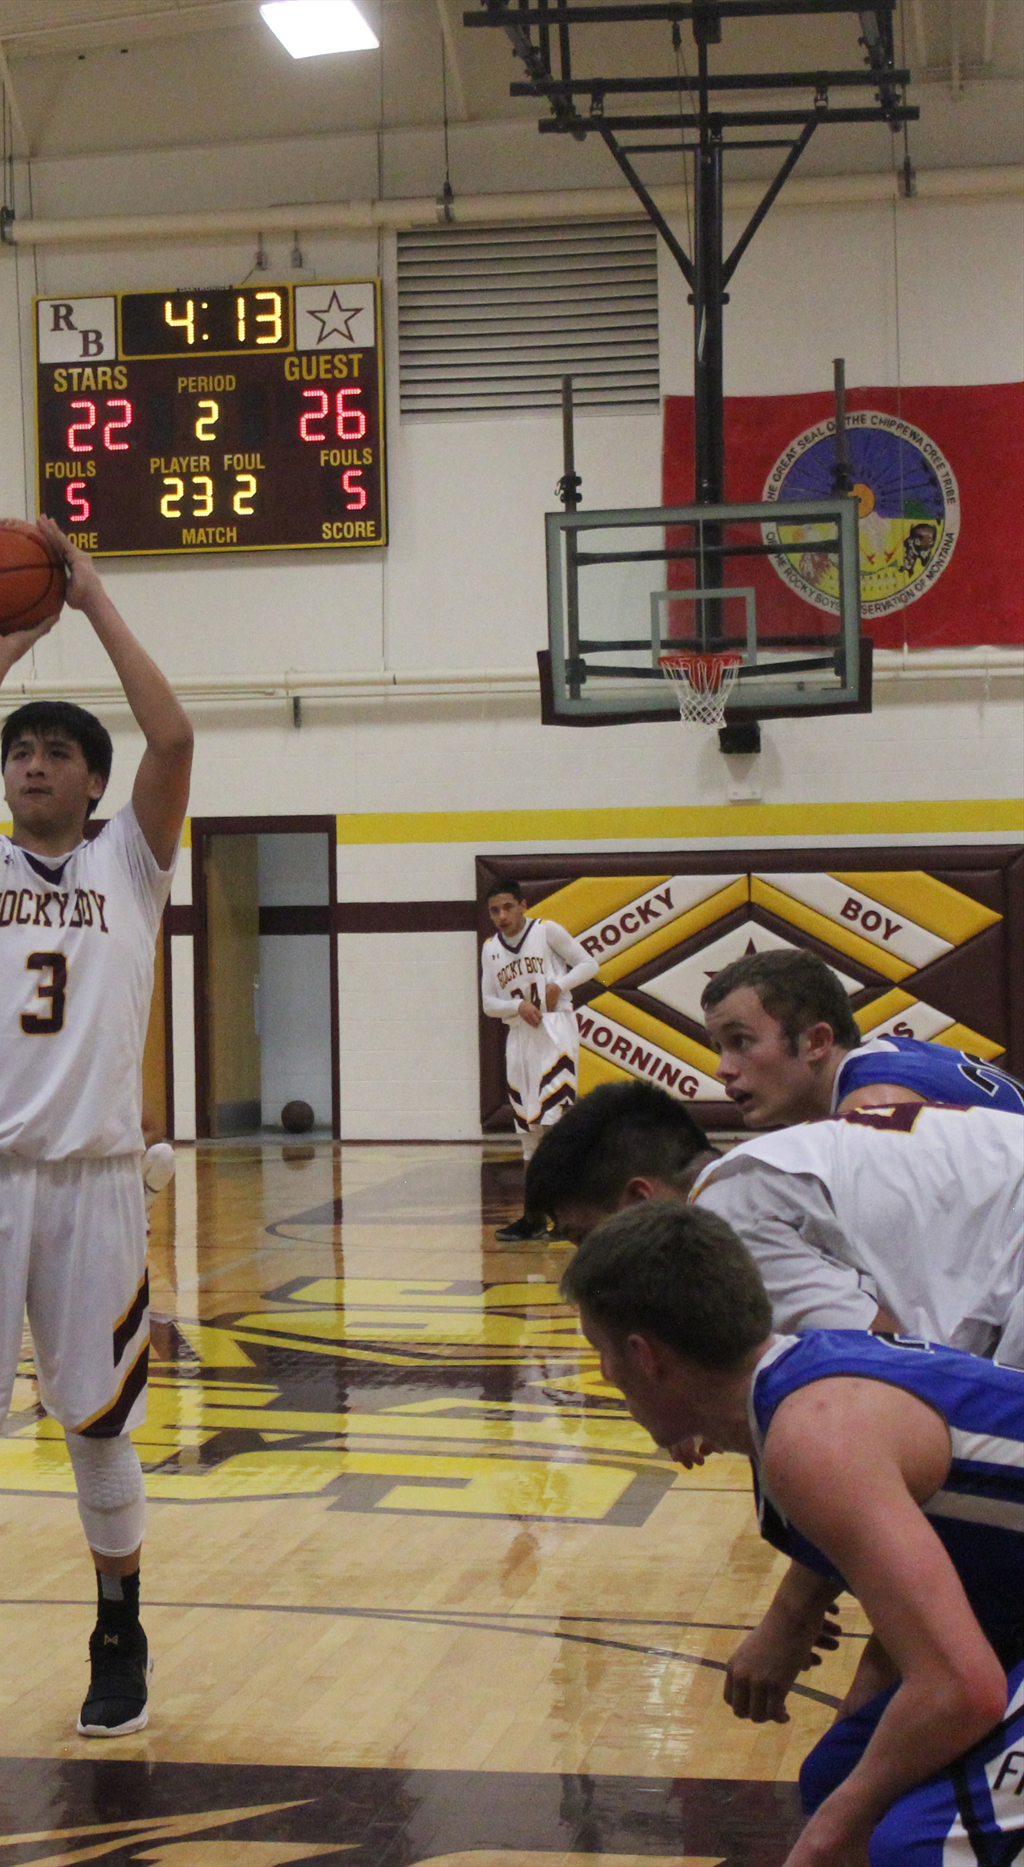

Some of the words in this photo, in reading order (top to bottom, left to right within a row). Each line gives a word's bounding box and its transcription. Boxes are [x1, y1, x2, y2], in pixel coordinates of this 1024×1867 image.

[164, 292, 282, 345] 4:13
[53, 366, 128, 393] STARS
[284, 354, 364, 381] GUEST
[177, 375, 236, 394] PERIOD
[67, 399, 133, 453] 22
[194, 400, 219, 441] 2
[299, 387, 366, 442] 26
[845, 414, 867, 426] THE
[870, 414, 925, 447] CHIPPEWA
[797, 427, 825, 450] SEAL
[45, 460, 96, 479] FOULS
[150, 455, 211, 474] PLAYER
[223, 452, 266, 471] FOUL
[320, 448, 373, 467] FOULS
[772, 447, 797, 483] GREAT
[923, 443, 946, 471] CREE
[66, 481, 90, 522] 5
[160, 476, 214, 518] 23
[233, 474, 257, 516] 2
[342, 469, 367, 511] 5
[767, 484, 778, 501] HE
[941, 471, 957, 505] TRIBE
[68, 532, 98, 549] ORE
[182, 527, 237, 545] MATCH
[321, 522, 376, 540] SCORE
[783, 567, 816, 598] ROCKY
[861, 588, 916, 615] SERVATION
[914, 578, 926, 592] OF
[926, 532, 955, 581] MONTANA
[580, 887, 677, 959] ROCKY
[839, 897, 903, 942] BOY
[524, 957, 544, 974] BOY
[19, 951, 69, 1036] 3
[575, 1011, 701, 1100] MORNING
